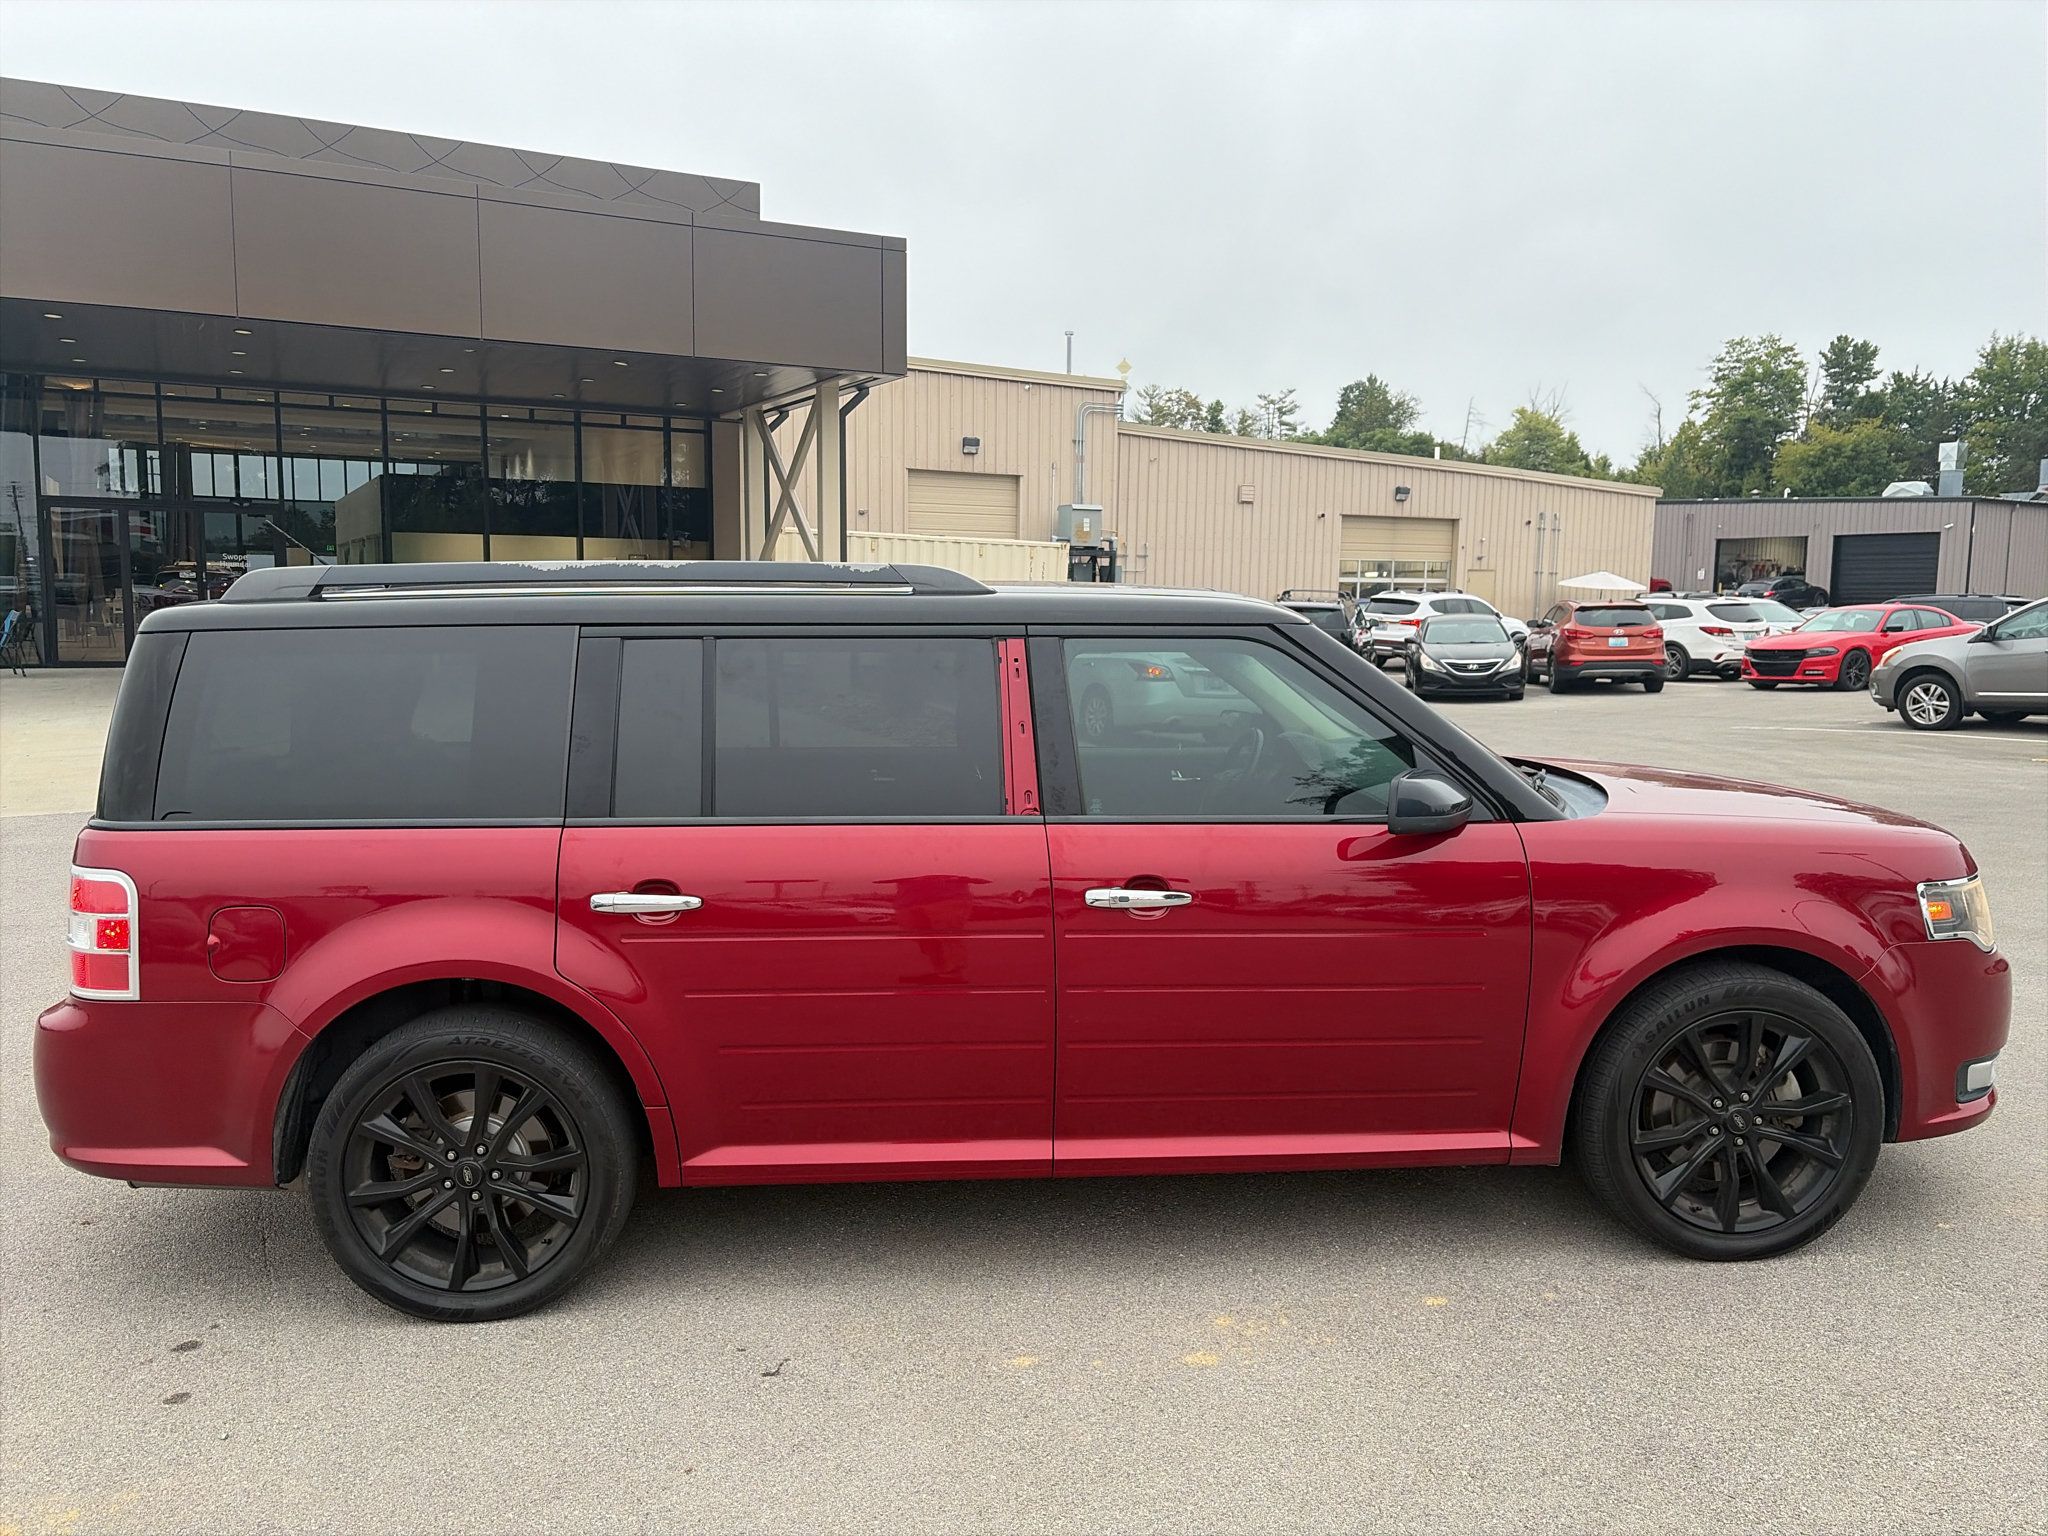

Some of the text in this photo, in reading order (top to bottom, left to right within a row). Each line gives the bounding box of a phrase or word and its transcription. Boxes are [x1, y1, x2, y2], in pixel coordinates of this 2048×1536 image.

[222, 552, 248, 562] Swope
[1645, 994, 1710, 1043] SAILUN
[447, 1035, 546, 1063] ATREZZO
